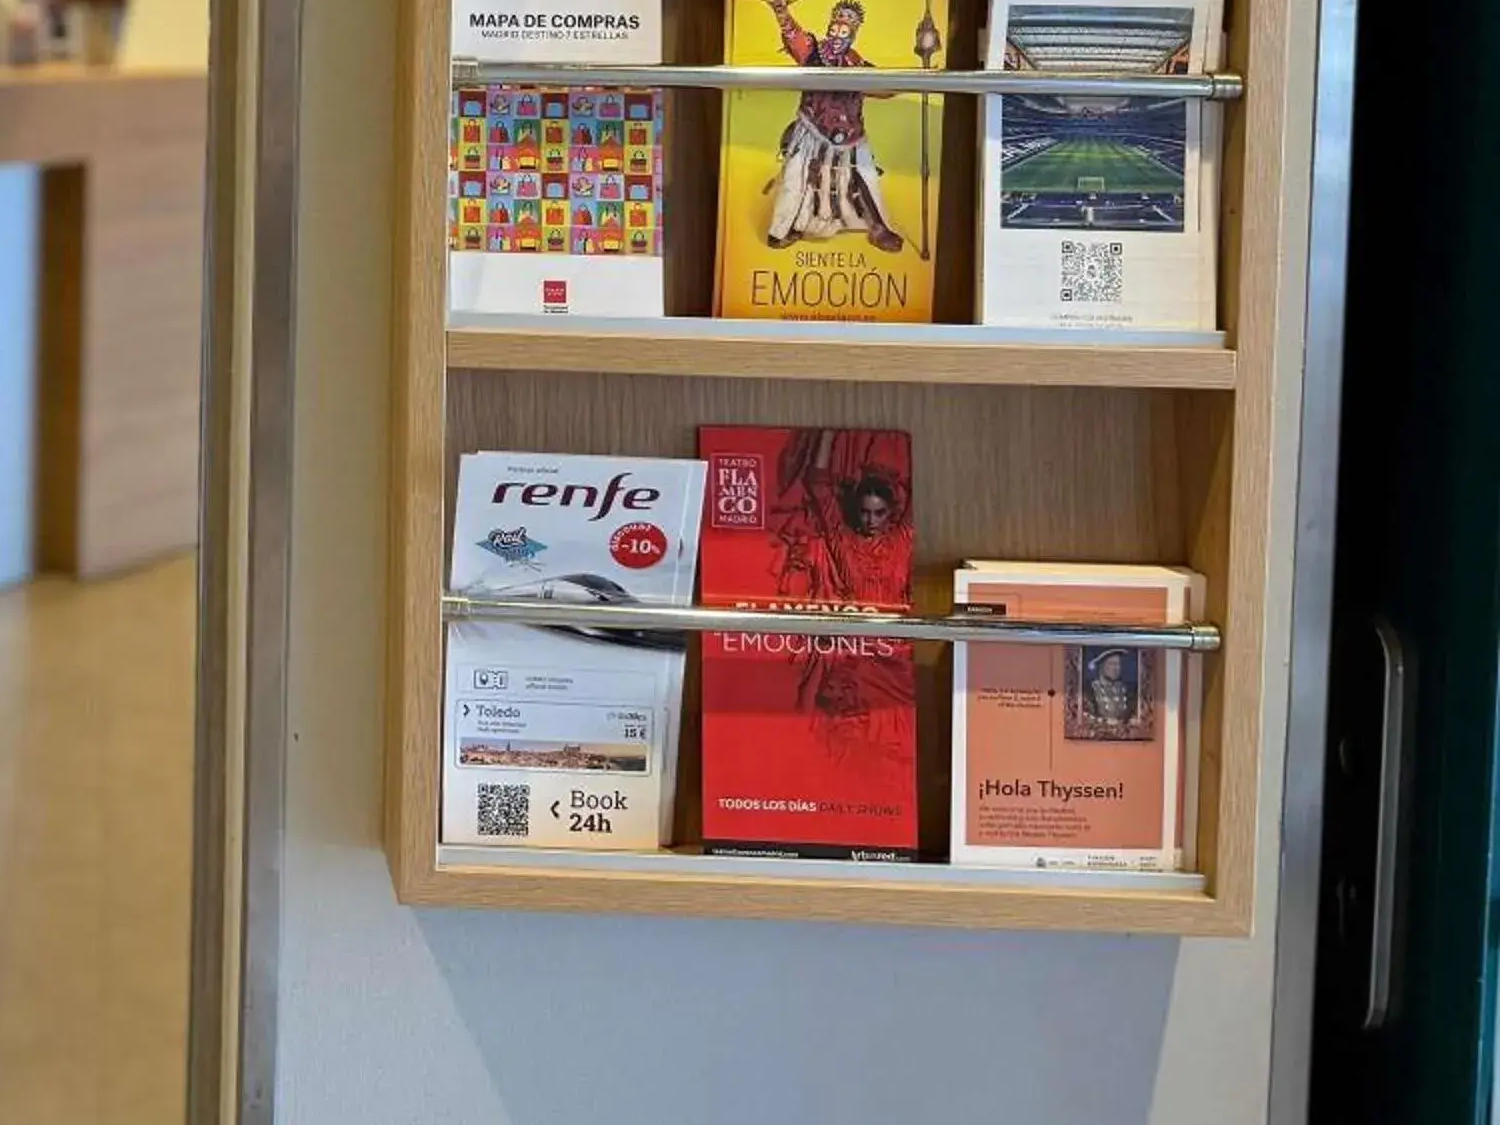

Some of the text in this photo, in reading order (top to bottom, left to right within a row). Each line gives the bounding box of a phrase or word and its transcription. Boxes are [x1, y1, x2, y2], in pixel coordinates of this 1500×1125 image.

[469, 14, 640, 29] MAPA DE COMPRAS
[796, 252, 867, 268] SIENTE LA
[752, 267, 907, 308] EMOCIÓN
[719, 458, 757, 468] TEATRO
[718, 468, 757, 486] FLA
[491, 473, 660, 521] renfe
[718, 496, 757, 514] CO
[476, 704, 521, 718] Toledo
[624, 728, 638, 739] 15
[978, 779, 1124, 802] ¡Hola Thyssen!
[570, 790, 628, 810] Book
[718, 798, 761, 810] TODOS
[763, 799, 787, 810] LOS
[789, 799, 817, 812] DÍAS
[569, 813, 612, 834] 24h
